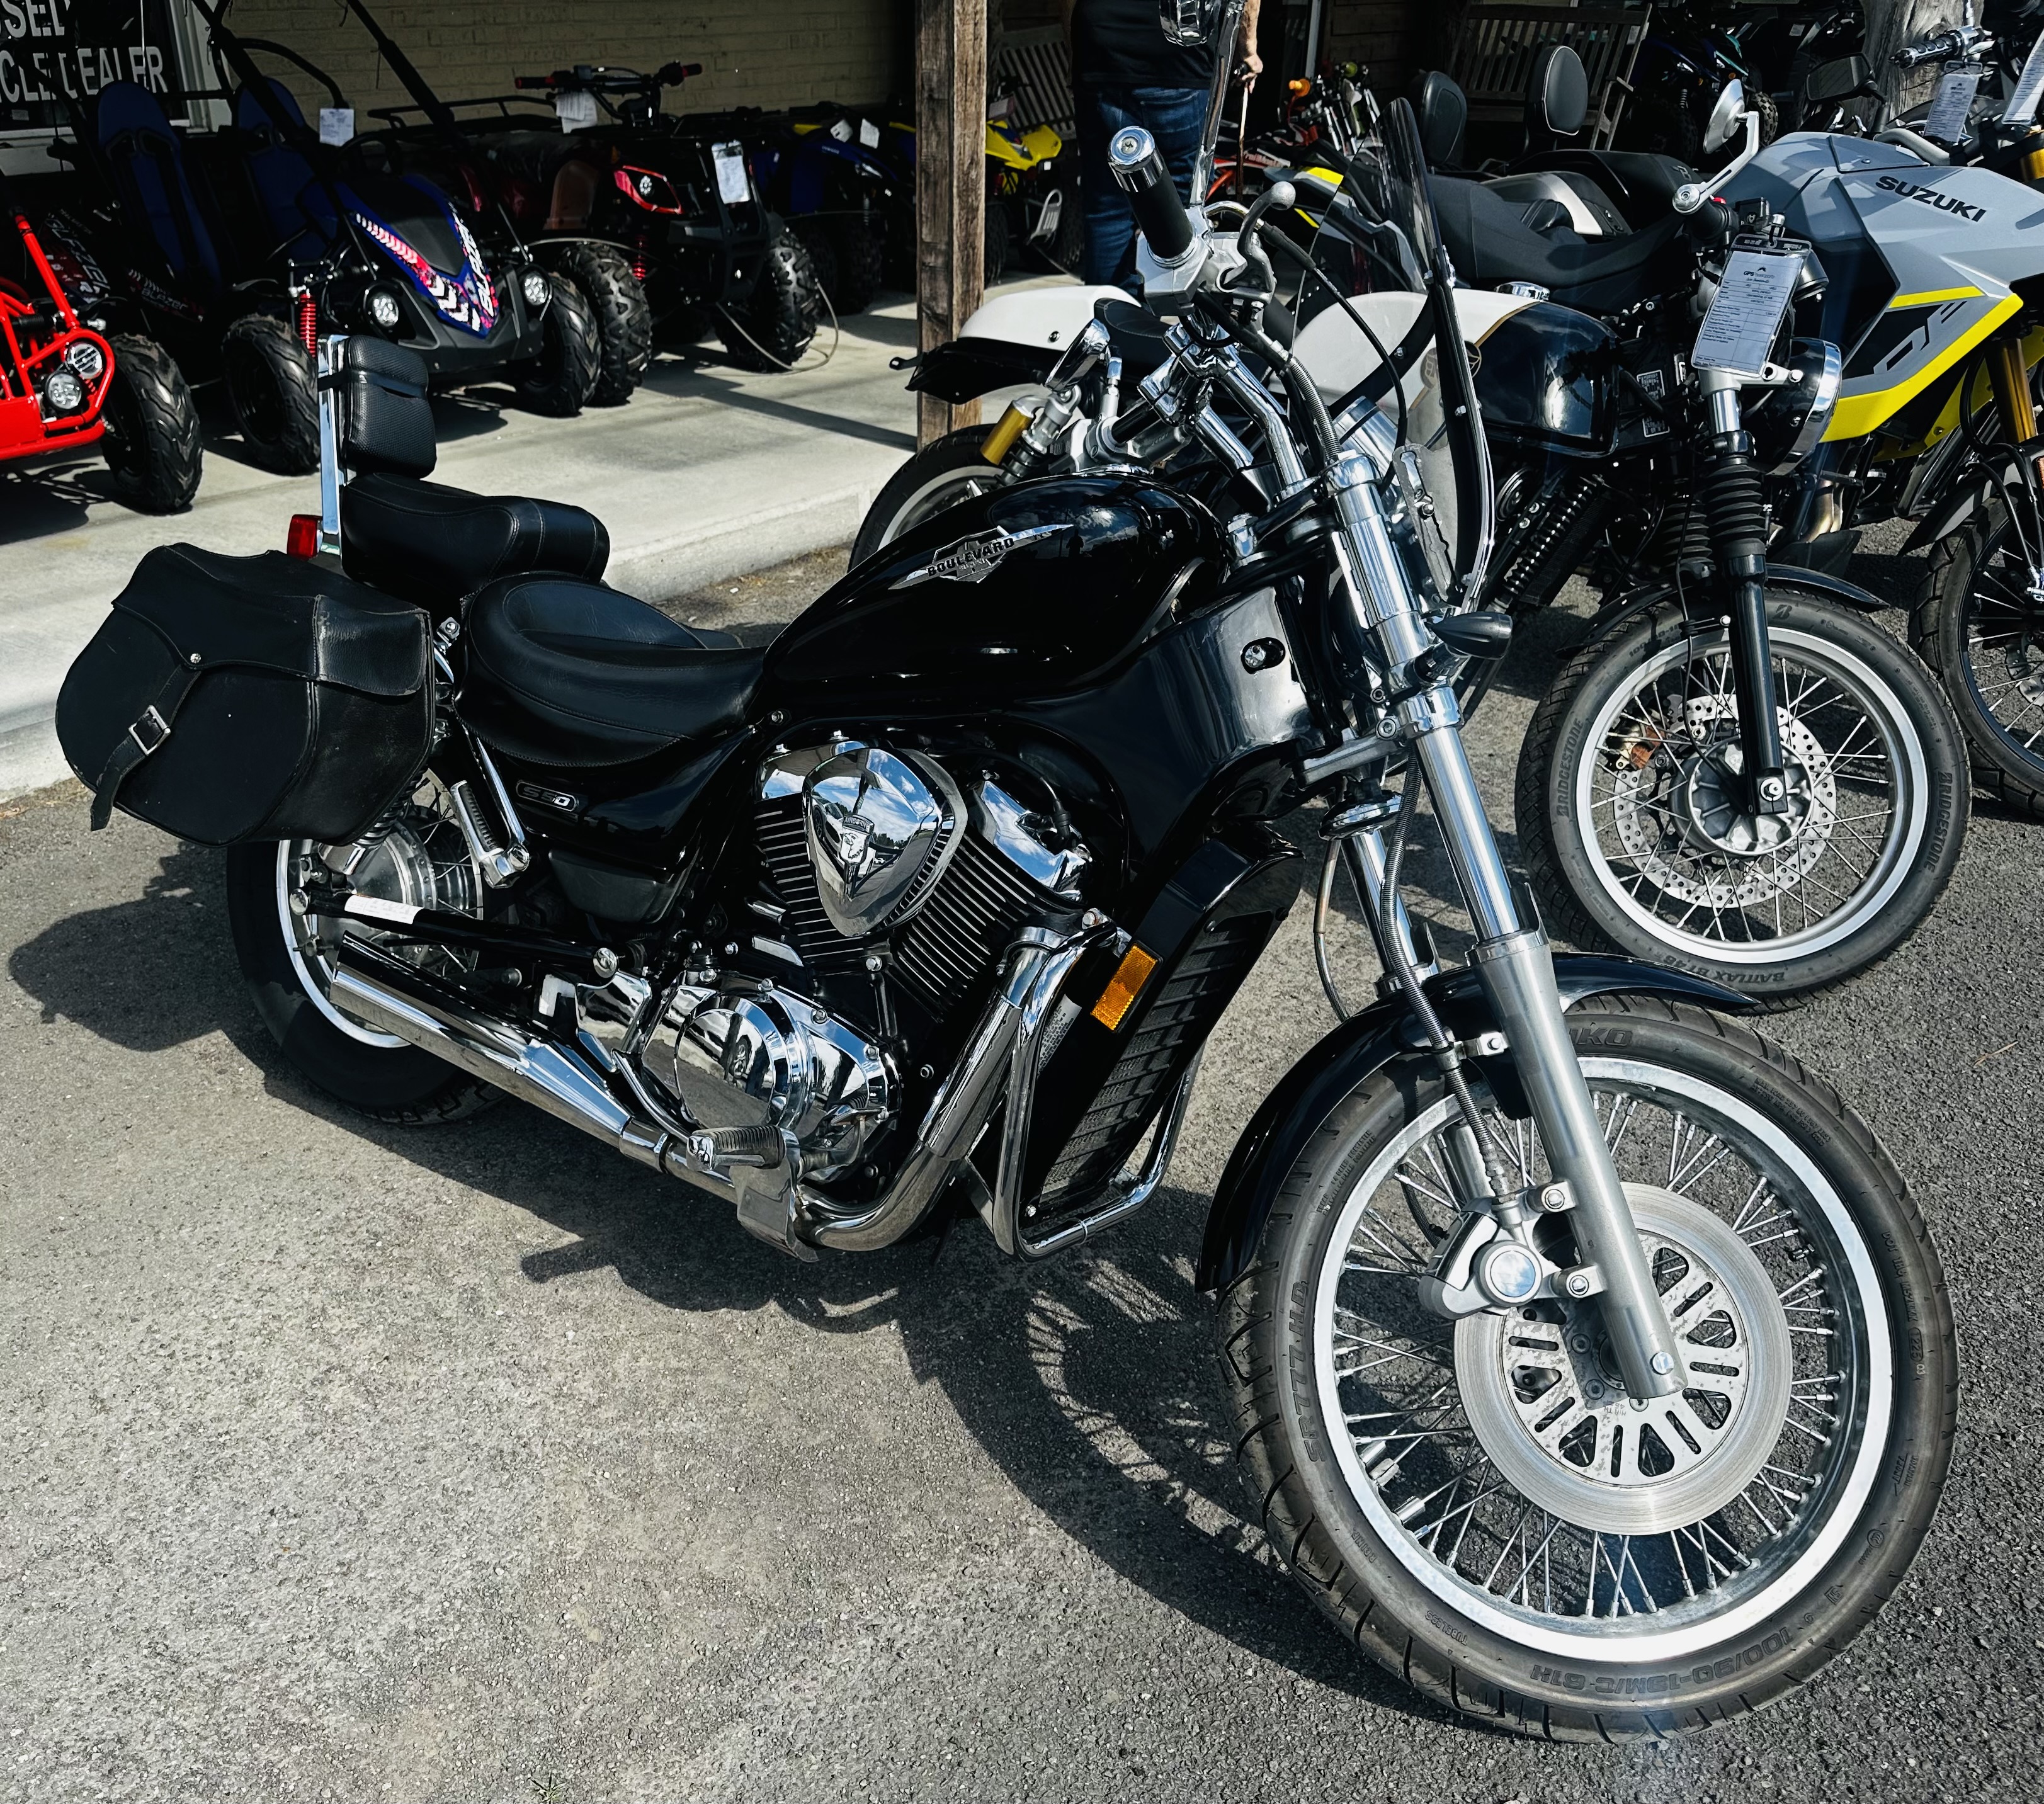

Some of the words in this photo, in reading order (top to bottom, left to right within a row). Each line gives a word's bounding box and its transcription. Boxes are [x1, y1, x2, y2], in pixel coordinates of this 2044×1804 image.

[0, 0, 71, 38] SED
[0, 50, 57, 103] CLE
[1875, 176, 1987, 222] SUZUKI
[926, 538, 1014, 577] BOULEVARD
[1555, 718, 1584, 819] BRIDGESTONE
[522, 786, 571, 807] S50
[844, 817, 870, 831] AIRBORNE
[1924, 771, 1953, 874] BRIDGESTONE
[1715, 970, 1785, 984] BATTLAX
[1911, 1332, 1922, 1360] 1225
[1289, 1344, 1326, 1463] SR777
[1424, 1609, 1468, 1646] TUBELESS
[1531, 1664, 1584, 1689] 61H
